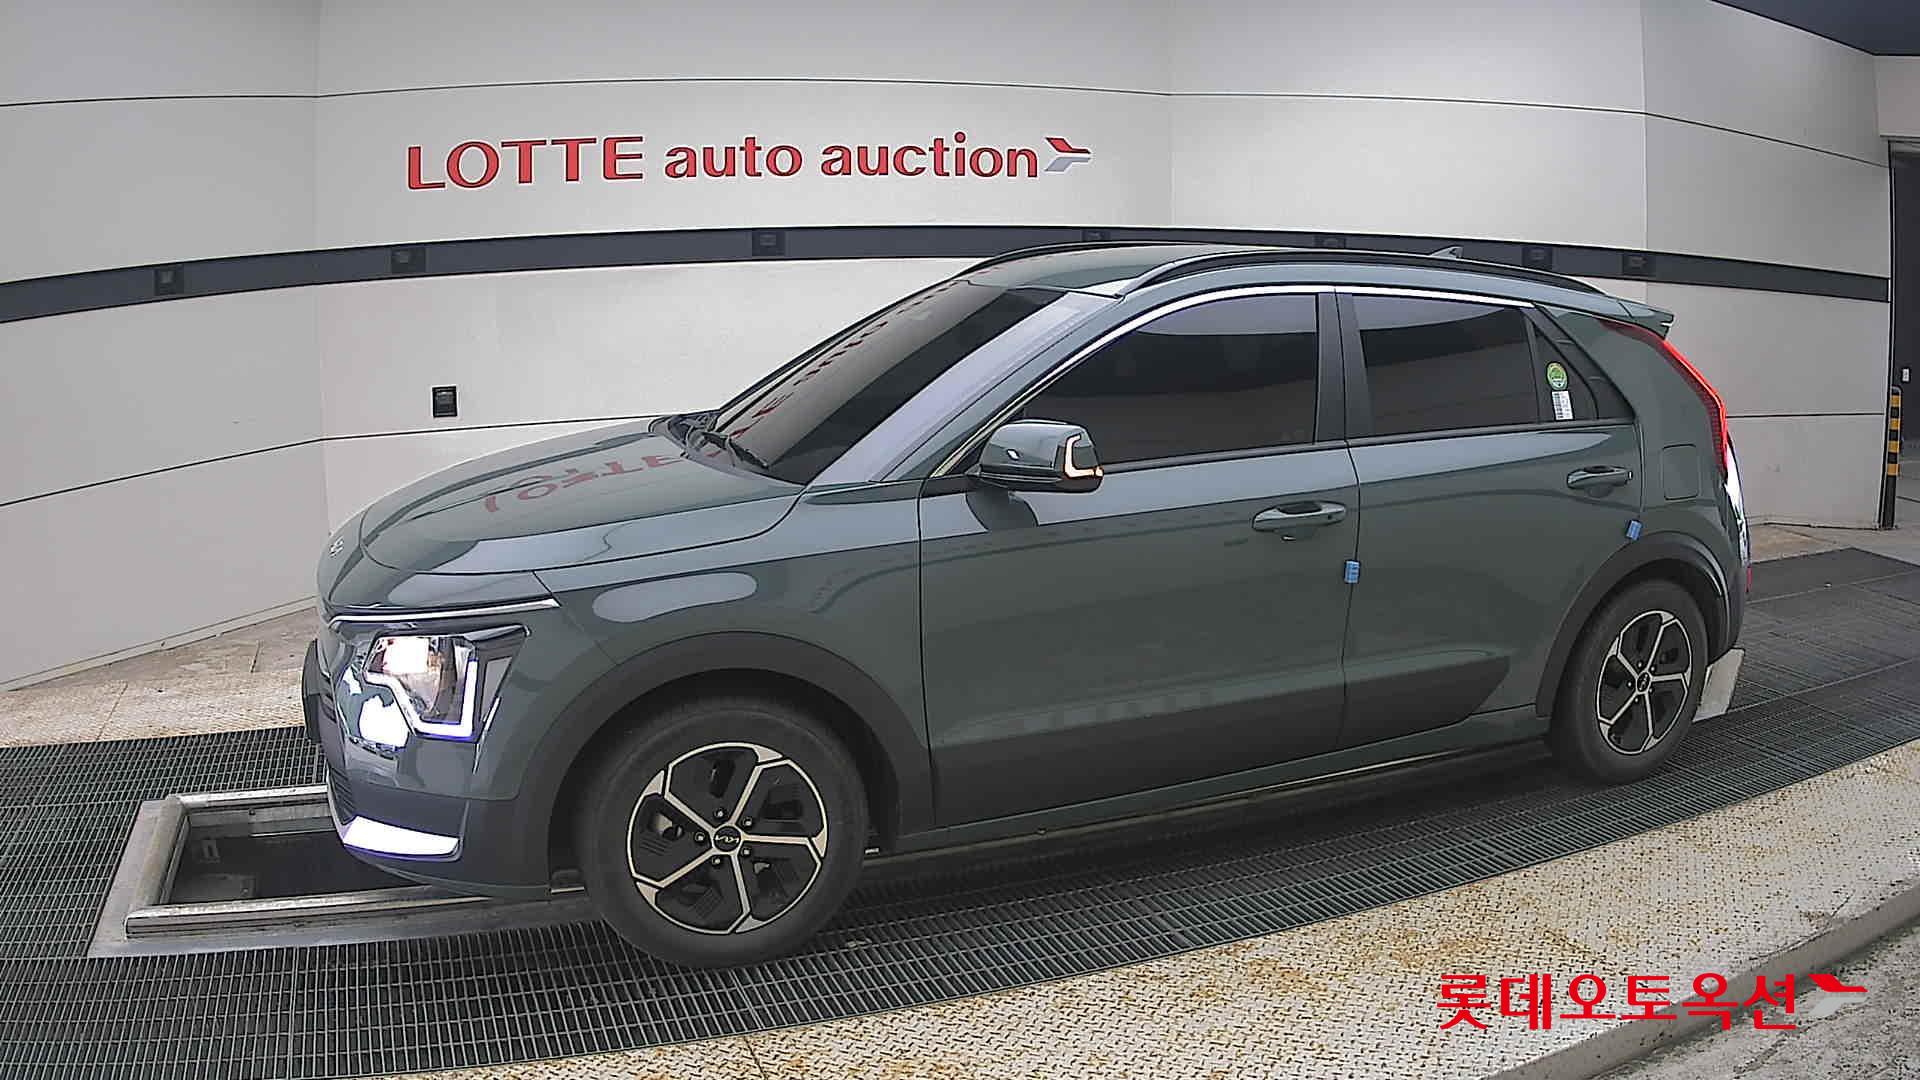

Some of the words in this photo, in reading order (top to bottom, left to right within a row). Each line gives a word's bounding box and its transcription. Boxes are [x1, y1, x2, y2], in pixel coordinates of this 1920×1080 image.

[407, 136, 642, 190] LOTTE
[665, 137, 802, 178] auto
[821, 132, 1038, 178] auction
